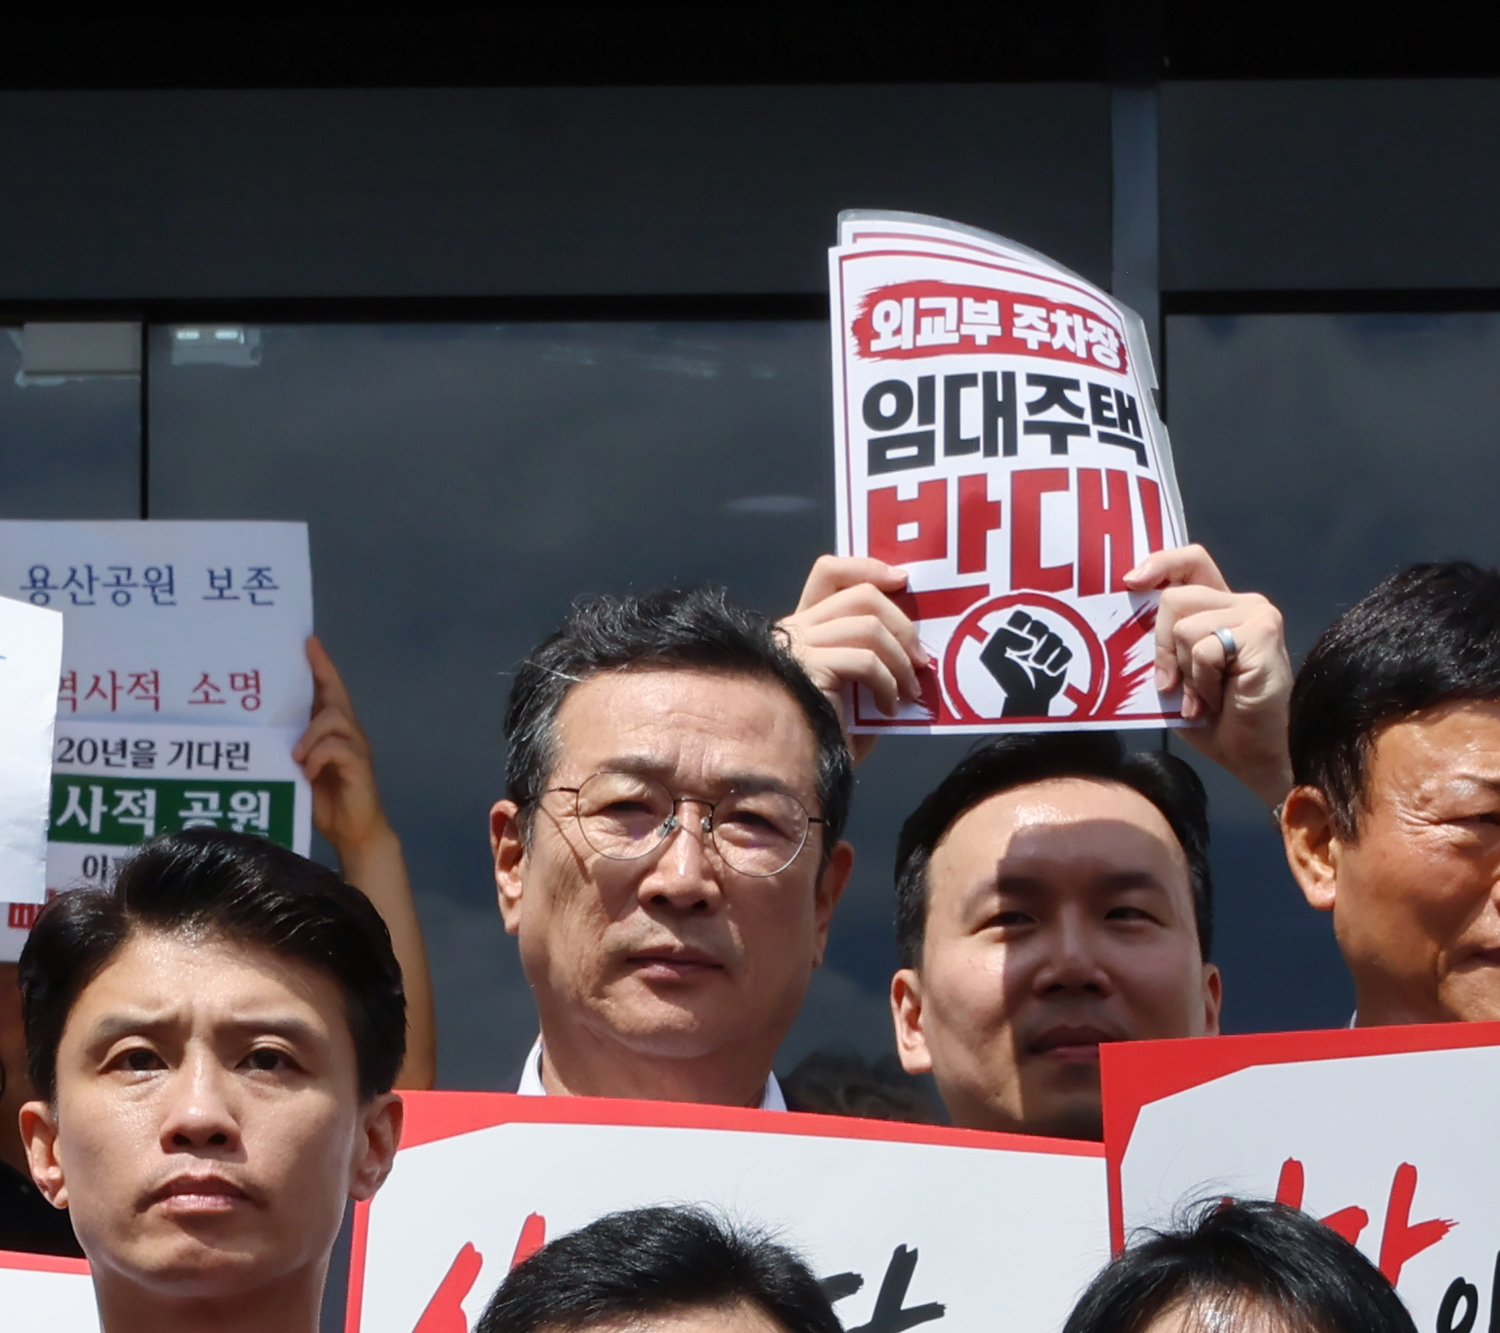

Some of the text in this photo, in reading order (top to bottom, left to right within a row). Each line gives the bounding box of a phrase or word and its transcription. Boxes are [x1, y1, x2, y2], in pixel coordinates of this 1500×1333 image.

[869, 296, 1122, 371] 외교부 주차장
[861, 370, 1150, 477] 임대주택
[19, 564, 280, 608] 용산공원 보존
[187, 668, 264, 713] 소명
[56, 737, 250, 772] 20년을 기다린
[55, 784, 158, 838] 사적
